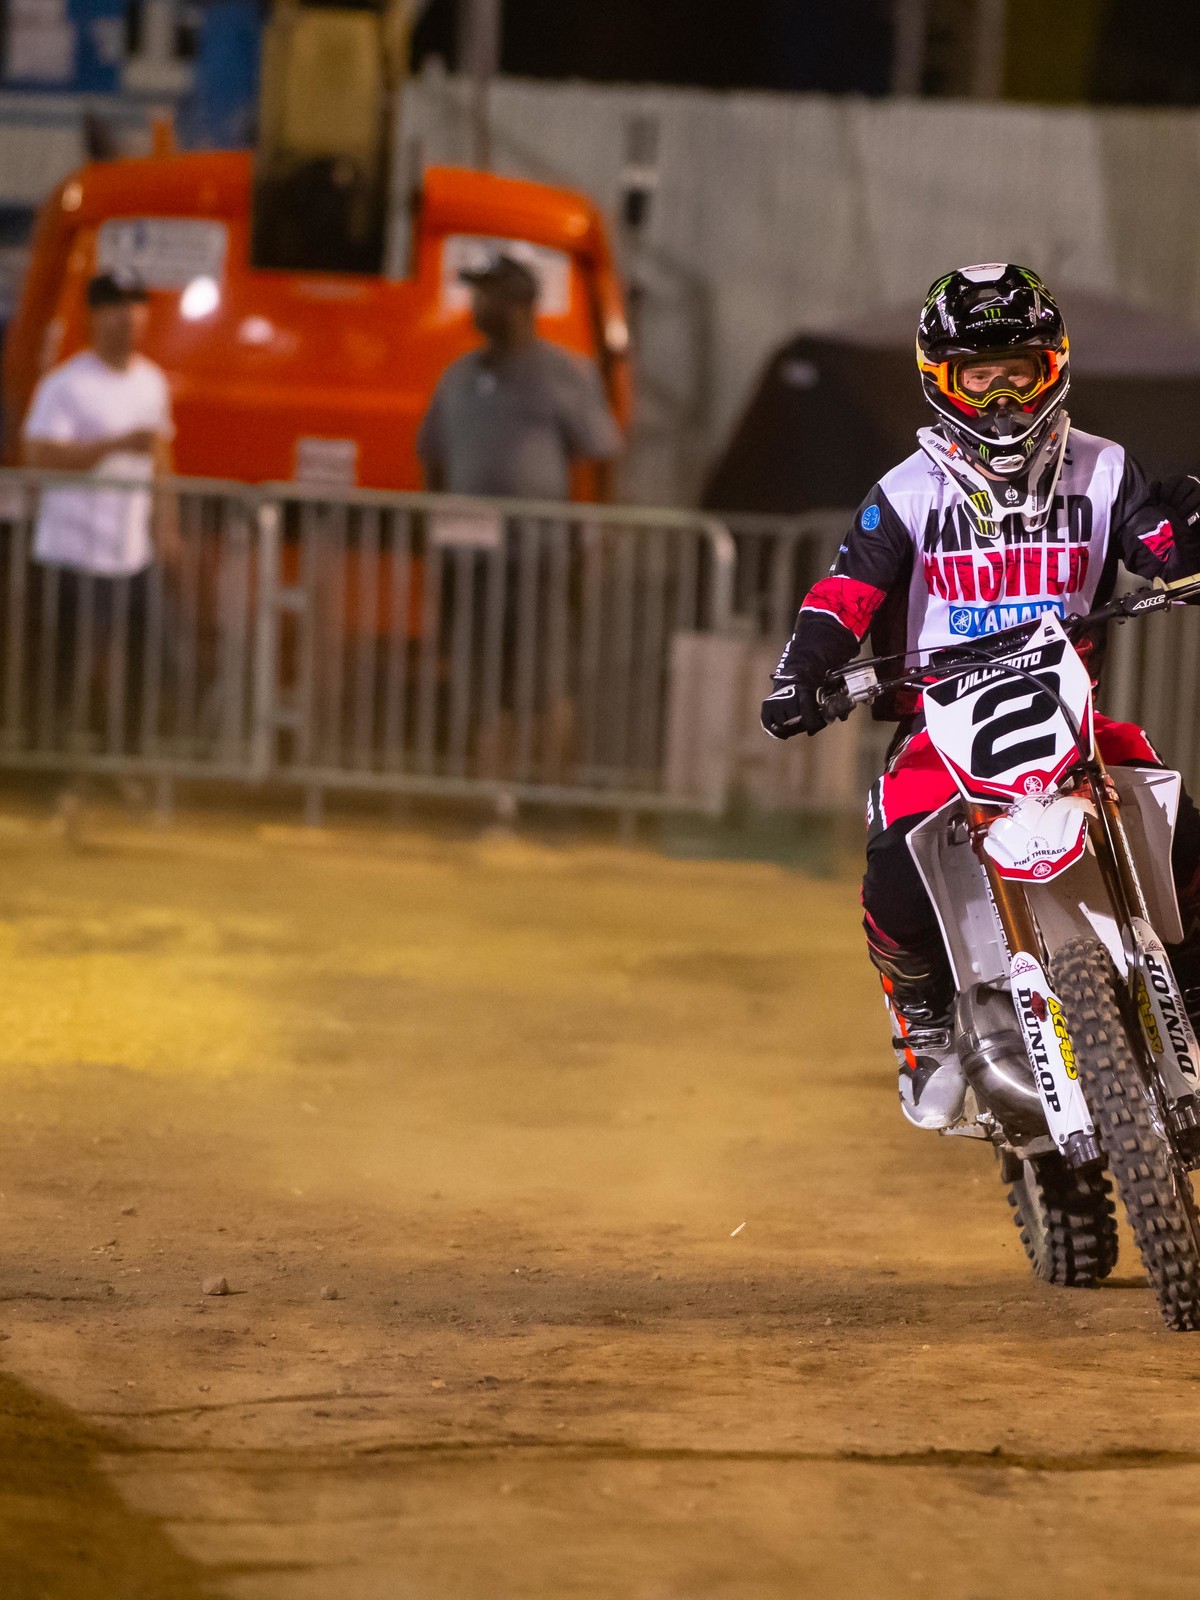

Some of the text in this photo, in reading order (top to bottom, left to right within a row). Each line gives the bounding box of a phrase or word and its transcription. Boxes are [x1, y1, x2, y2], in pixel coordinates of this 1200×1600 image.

[1131, 594, 1166, 611] ARC
[970, 671, 1062, 780] 2
[1013, 856, 1033, 868] PINE
[1031, 846, 1068, 860] THREADS
[1017, 987, 1062, 1113] DUNLOP
[1144, 953, 1198, 1078] DUNLOP
[1173, 994, 1191, 1033] YAMAHA
